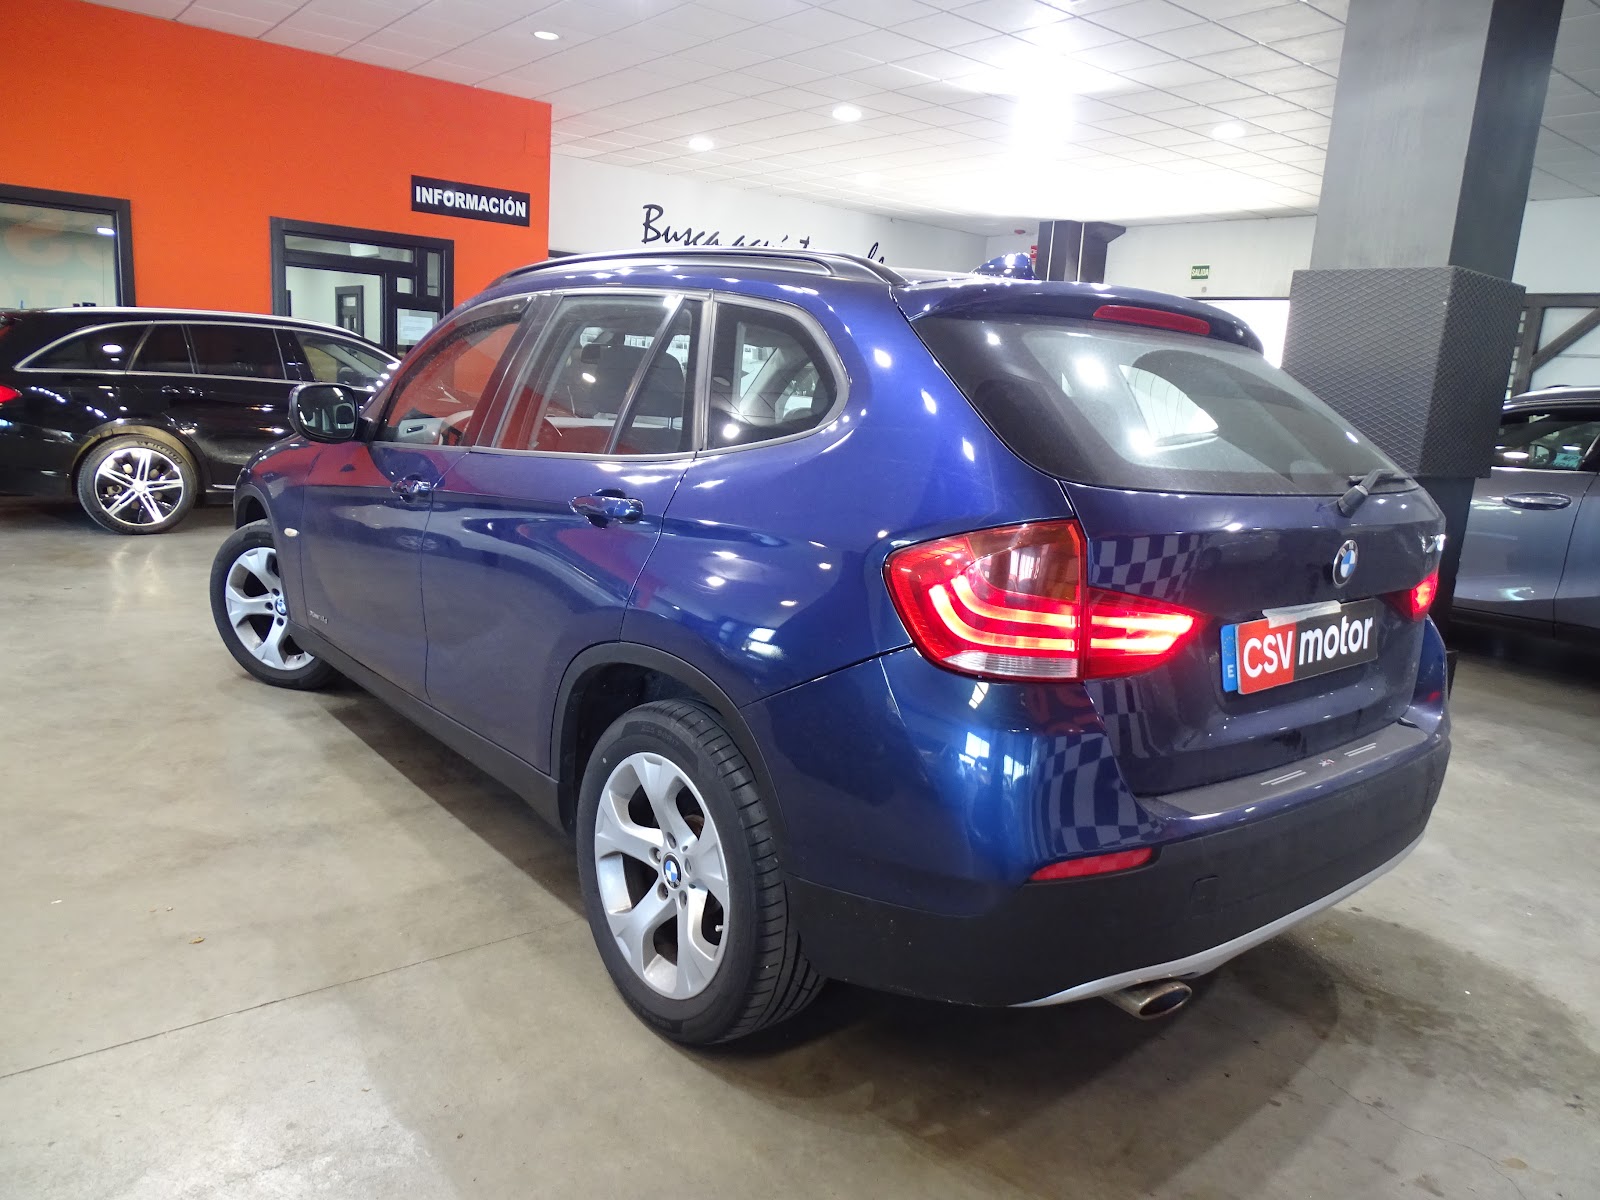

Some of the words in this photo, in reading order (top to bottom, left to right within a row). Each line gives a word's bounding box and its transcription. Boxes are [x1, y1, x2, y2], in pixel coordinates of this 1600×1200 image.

[415, 185, 526, 218] INFORMACIÓN
[1243, 631, 1293, 677] CSV
[1298, 615, 1373, 665] motor
[1227, 664, 1235, 678] E
